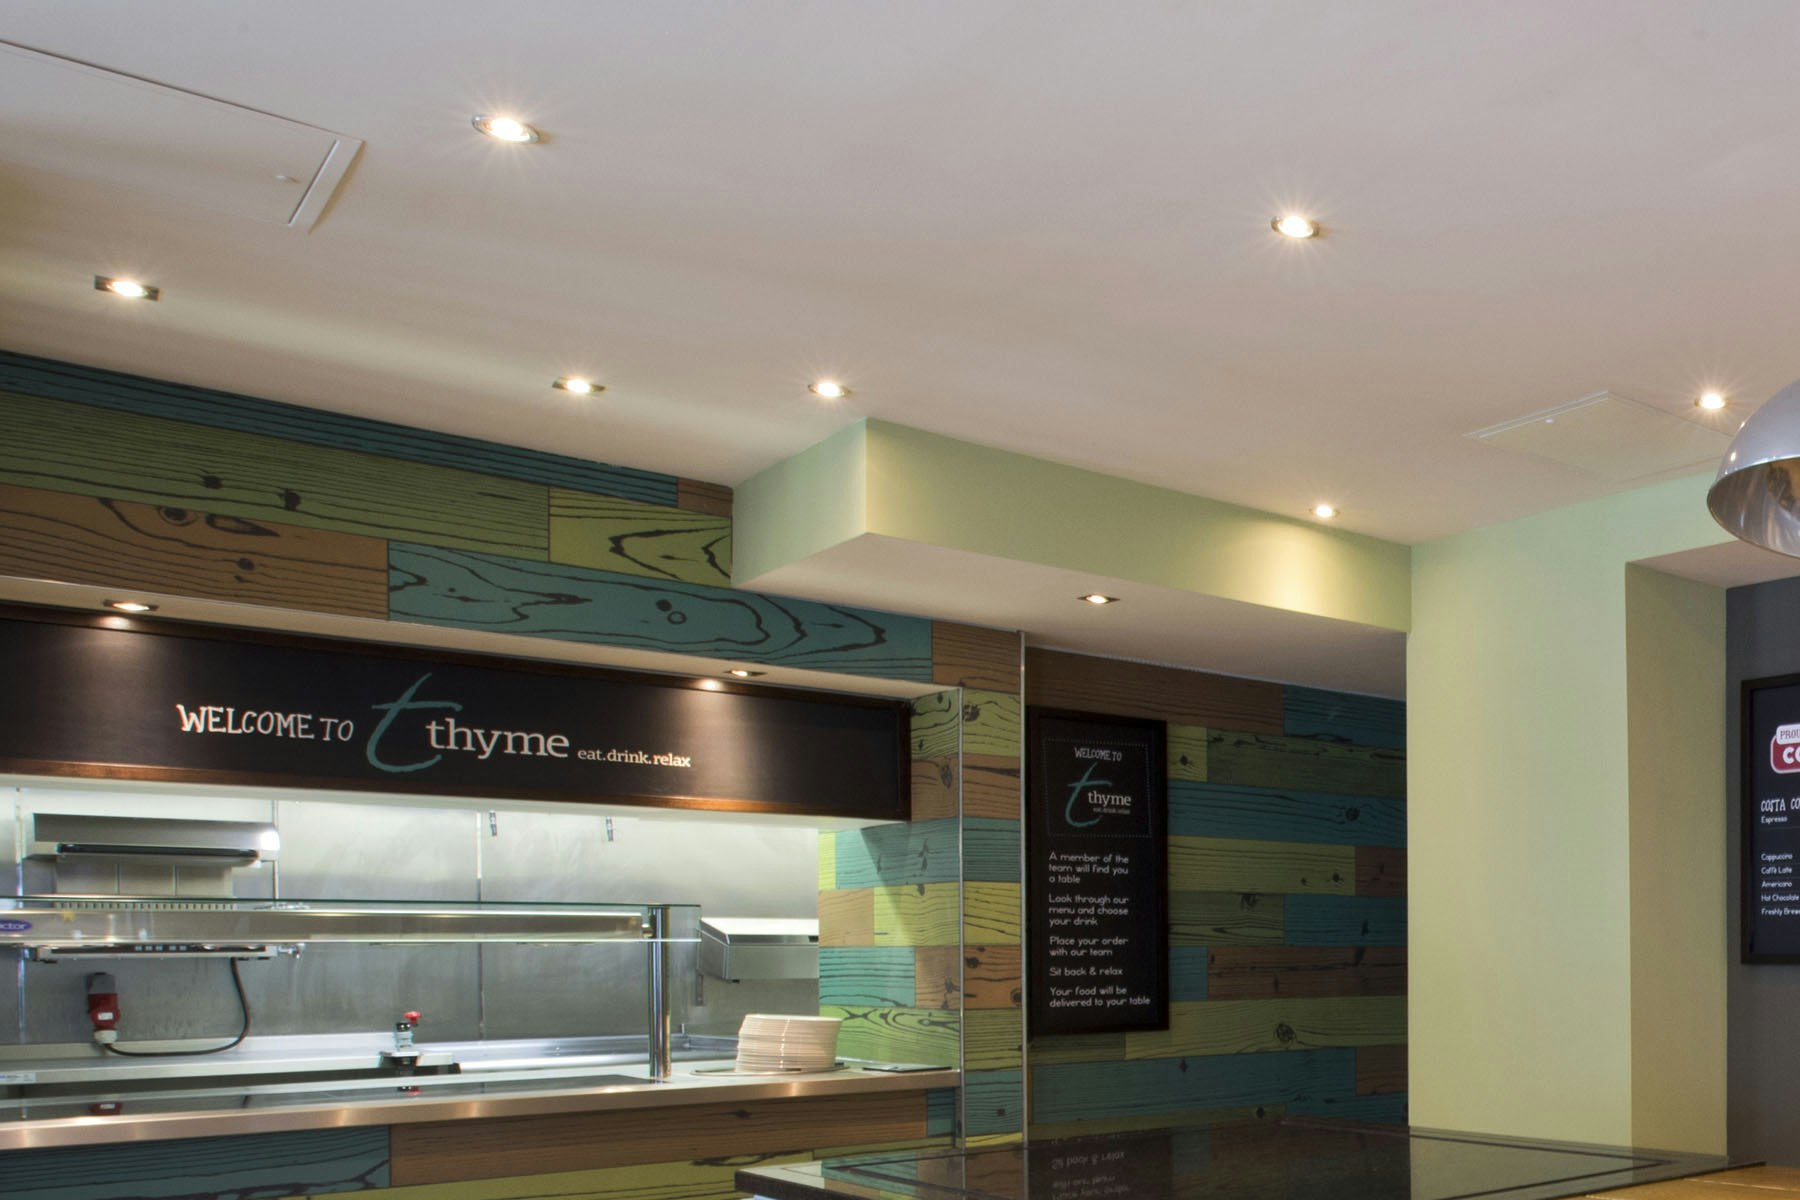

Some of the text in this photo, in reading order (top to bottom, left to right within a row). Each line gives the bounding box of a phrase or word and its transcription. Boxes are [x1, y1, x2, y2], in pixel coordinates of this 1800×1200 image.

[175, 703, 355, 742] WELCOME TO
[425, 717, 570, 760] thyme
[1074, 747, 1122, 762] WELCOME TO
[1088, 790, 1131, 807] thyme
[1760, 799, 1786, 813] COSTA
[1760, 815, 1788, 825] Espresso
[1049, 851, 1129, 864] A member of the
[1760, 852, 1793, 862] Cappuccino
[1048, 863, 1129, 876] team will find you
[1058, 874, 1081, 884] table
[1761, 880, 1793, 888] Americano
[1049, 893, 1073, 903] Look
[1075, 894, 1111, 906] through
[1077, 906, 1095, 915] and
[1097, 906, 1129, 915] choose
[1049, 917, 1098, 928] your drink
[1049, 936, 1129, 948] Place your order
[1049, 947, 1068, 956] with
[1090, 948, 1113, 956] team
[1049, 966, 1123, 976] Sit back & relax
[1050, 985, 1127, 996] Your food will be
[1049, 996, 1151, 1008] delivered to your table
